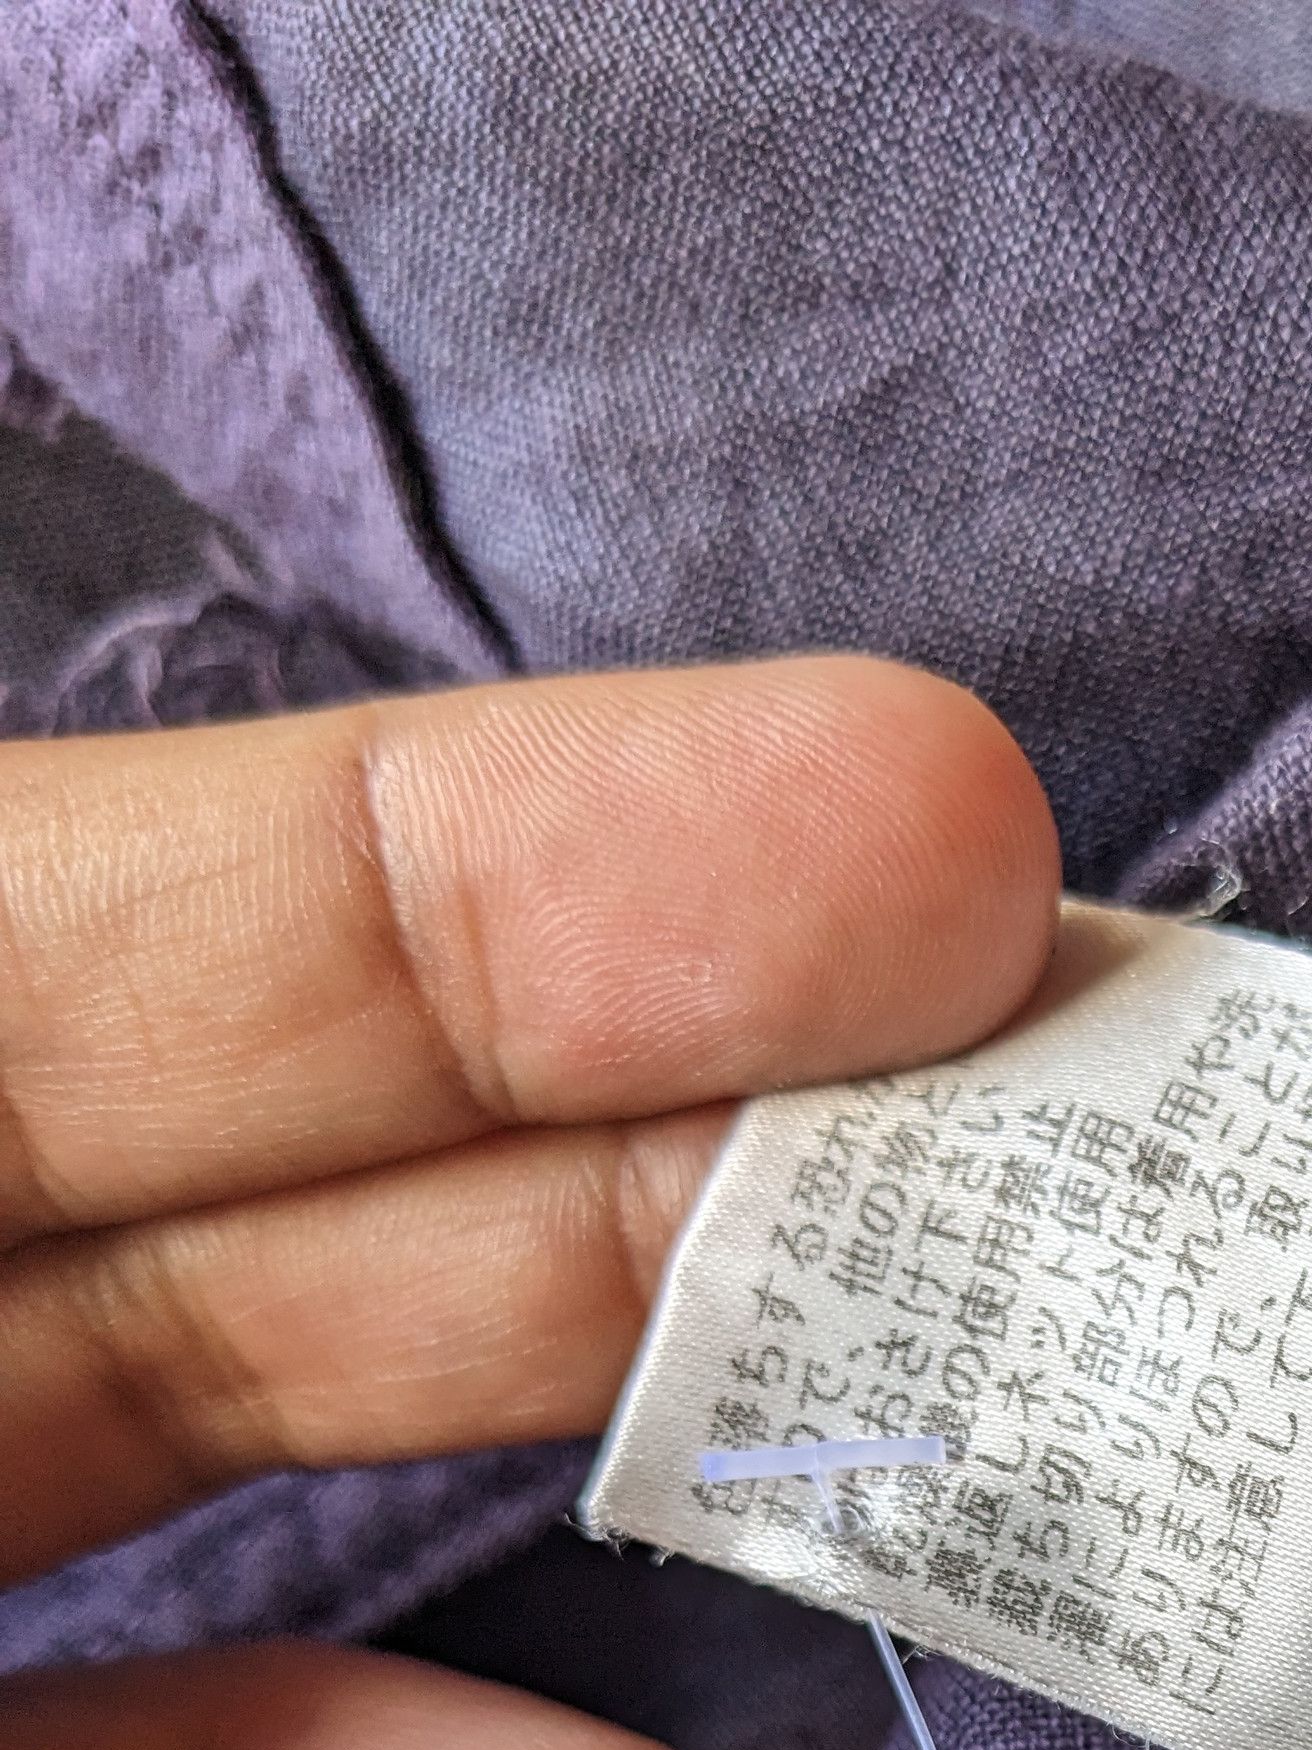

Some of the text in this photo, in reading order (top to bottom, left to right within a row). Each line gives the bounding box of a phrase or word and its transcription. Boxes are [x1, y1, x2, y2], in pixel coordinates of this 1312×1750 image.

[923, 1108, 1133, 1608] 裏返しネット使用
